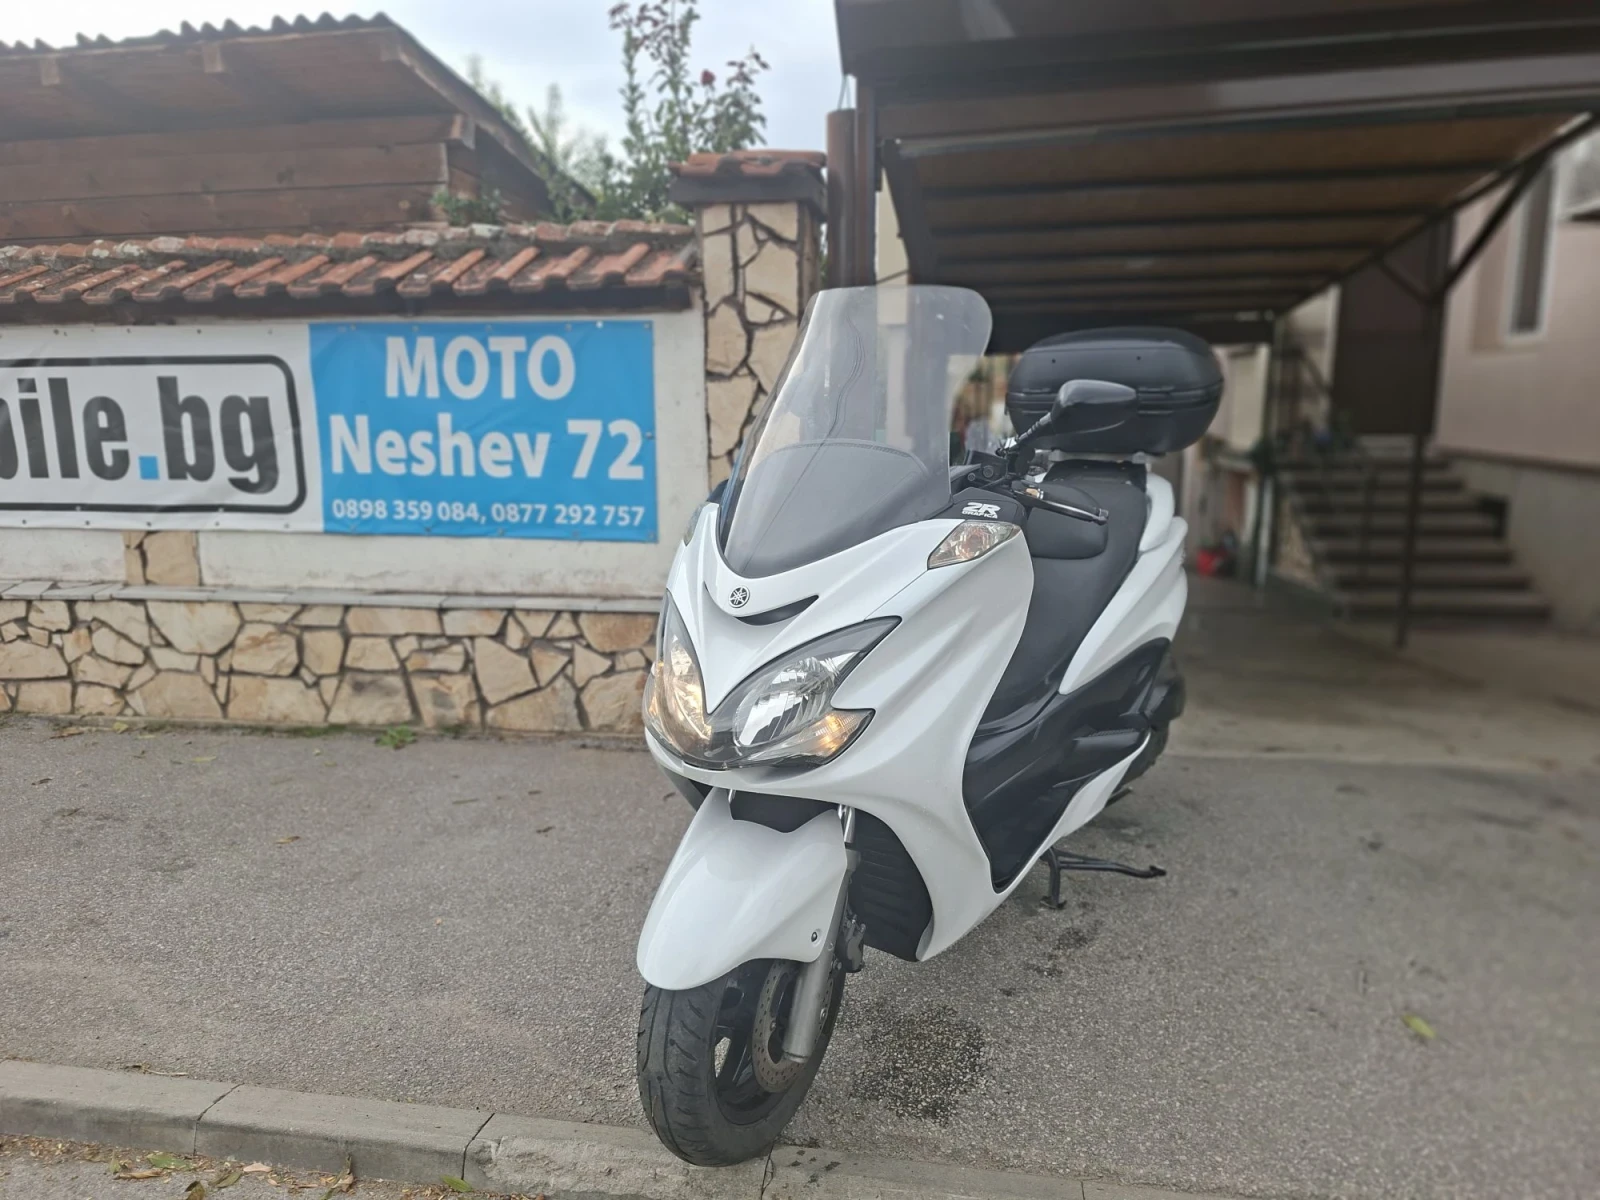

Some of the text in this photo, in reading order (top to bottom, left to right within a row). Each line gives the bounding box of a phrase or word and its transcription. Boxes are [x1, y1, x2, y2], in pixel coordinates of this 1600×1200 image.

[385, 334, 576, 400] MOTO
[329, 412, 645, 481] Neshev 72
[332, 499, 645, 527] 0898 359 084, 0877 292 757
